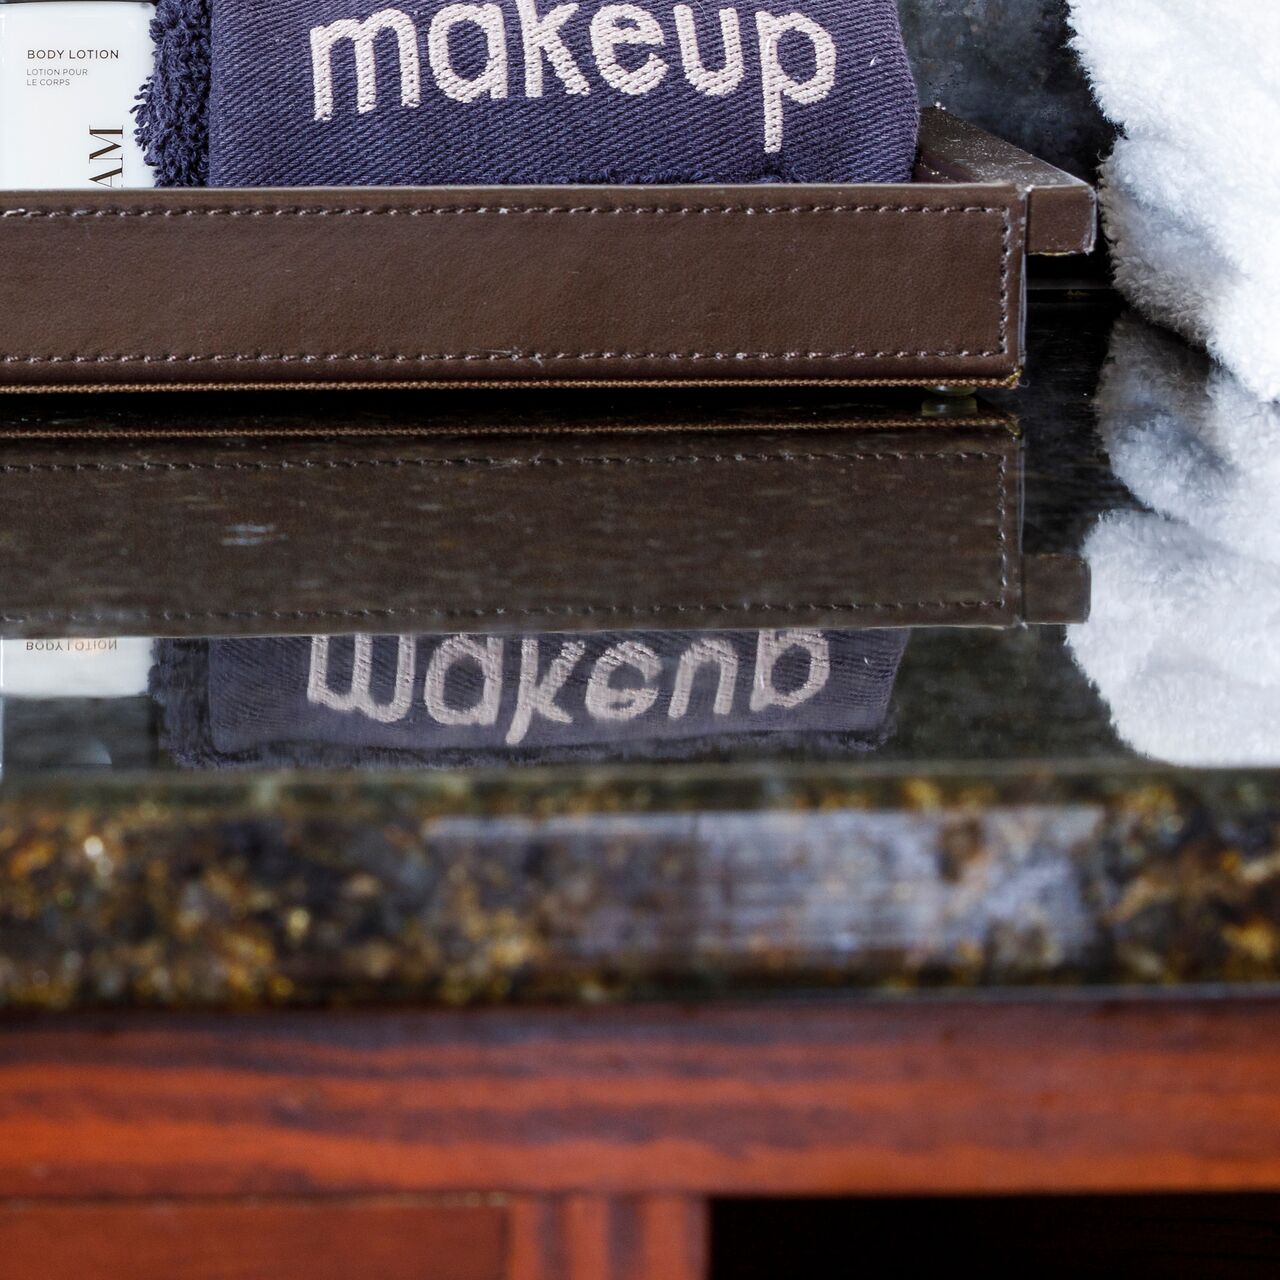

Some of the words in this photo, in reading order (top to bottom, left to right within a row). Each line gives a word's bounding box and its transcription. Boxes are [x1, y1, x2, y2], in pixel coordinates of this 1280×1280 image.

[27, 49, 65, 60] BODY
[69, 49, 120, 60] LOTION
[26, 68, 60, 76] LOTION
[62, 68, 88, 76] POUR
[26, 79, 37, 87] LE
[39, 79, 71, 87] CORPS
